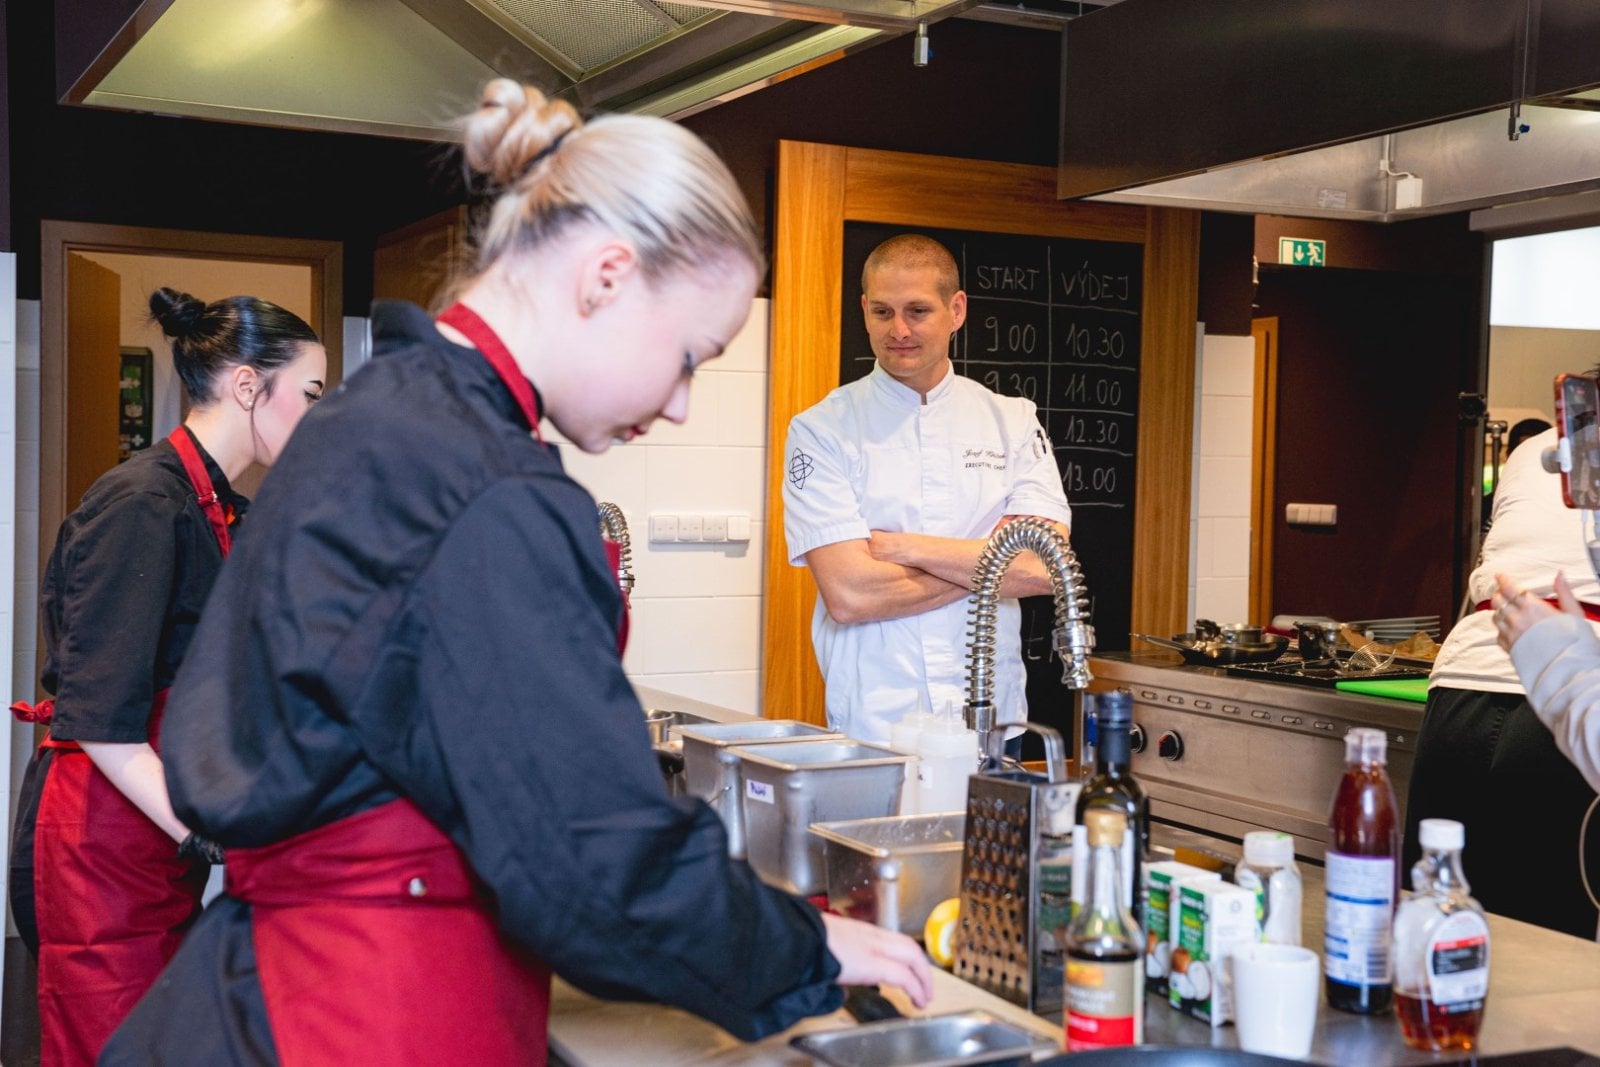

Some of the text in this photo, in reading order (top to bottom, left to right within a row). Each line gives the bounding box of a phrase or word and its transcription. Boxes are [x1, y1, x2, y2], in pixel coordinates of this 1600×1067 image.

[977, 260, 1128, 301] START VÝDEJ
[1066, 322, 1124, 359] 10.30
[1064, 415, 1119, 444] 12.30
[1063, 461, 1116, 493] 13.00
